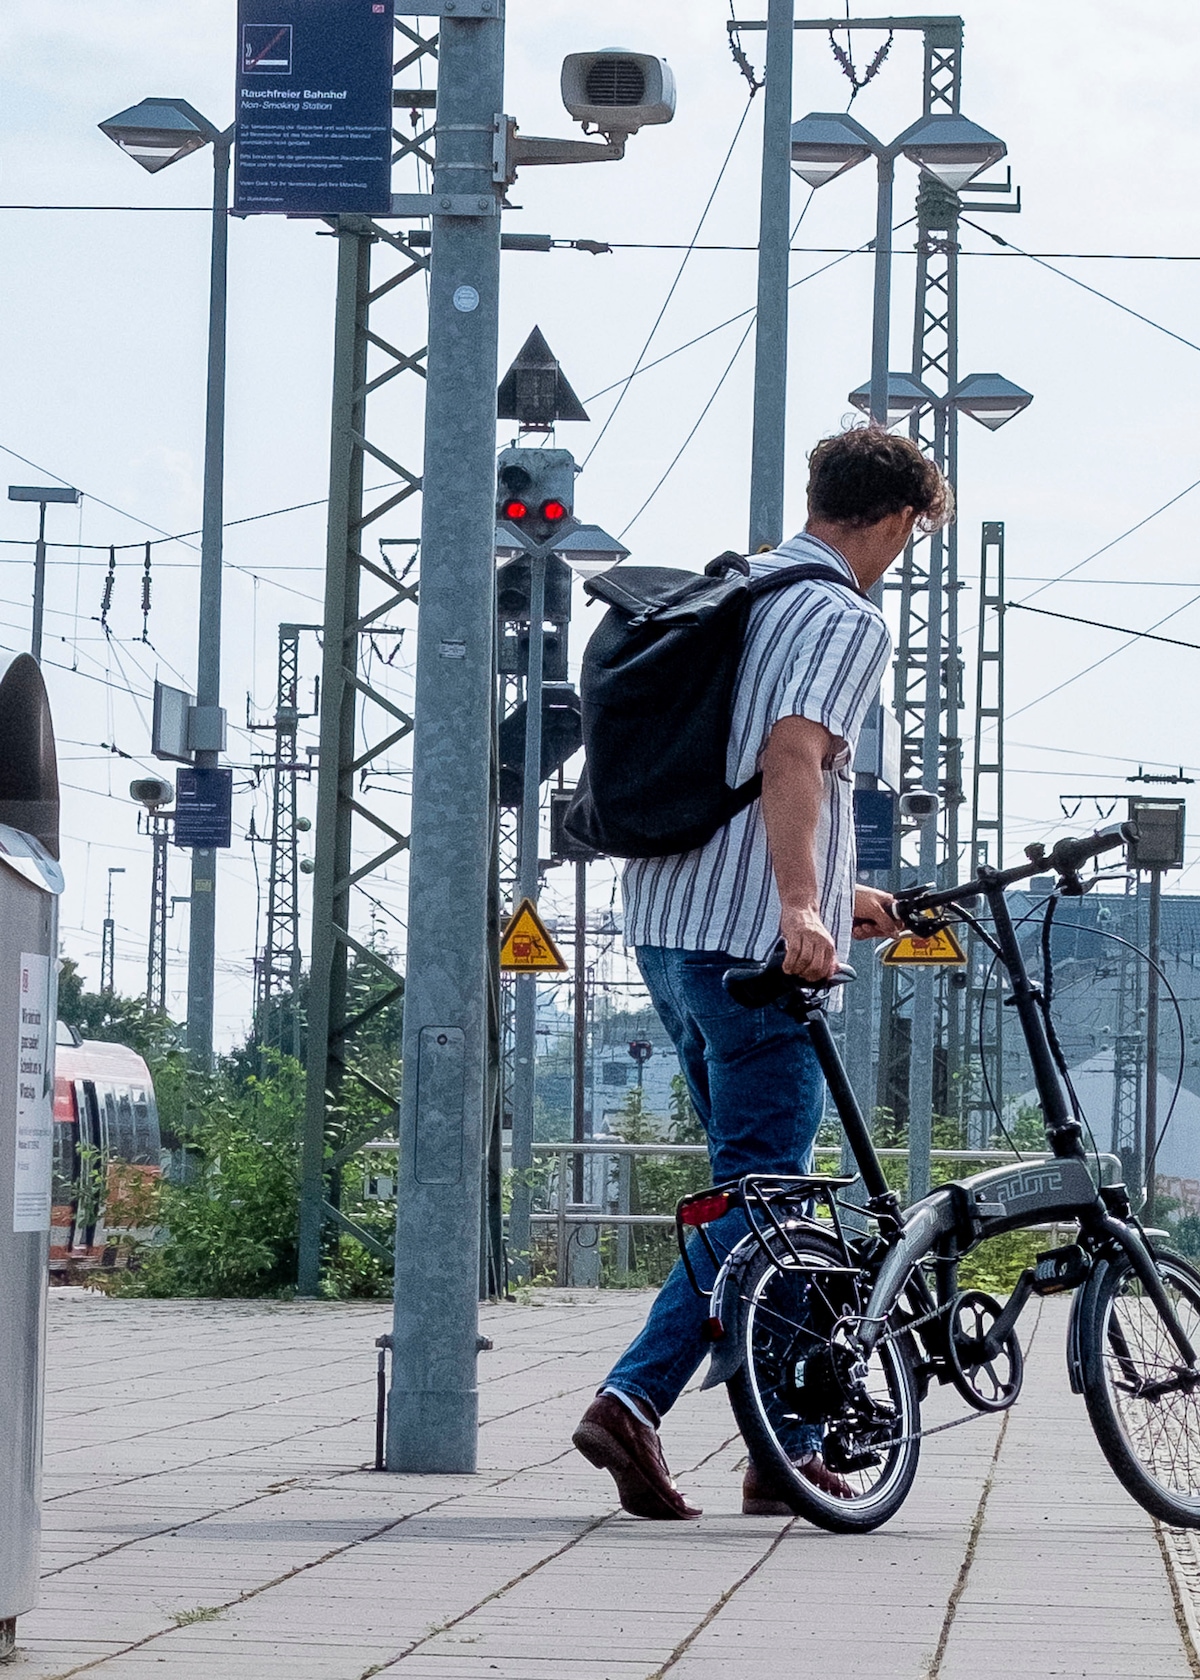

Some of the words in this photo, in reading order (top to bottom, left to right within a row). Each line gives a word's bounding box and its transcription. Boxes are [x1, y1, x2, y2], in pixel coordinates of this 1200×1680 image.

[240, 88, 301, 99] Rauchfreier
[303, 89, 348, 100] Bahnhof
[240, 100, 300, 111] Non-Smoking
[301, 101, 333, 110] Station
